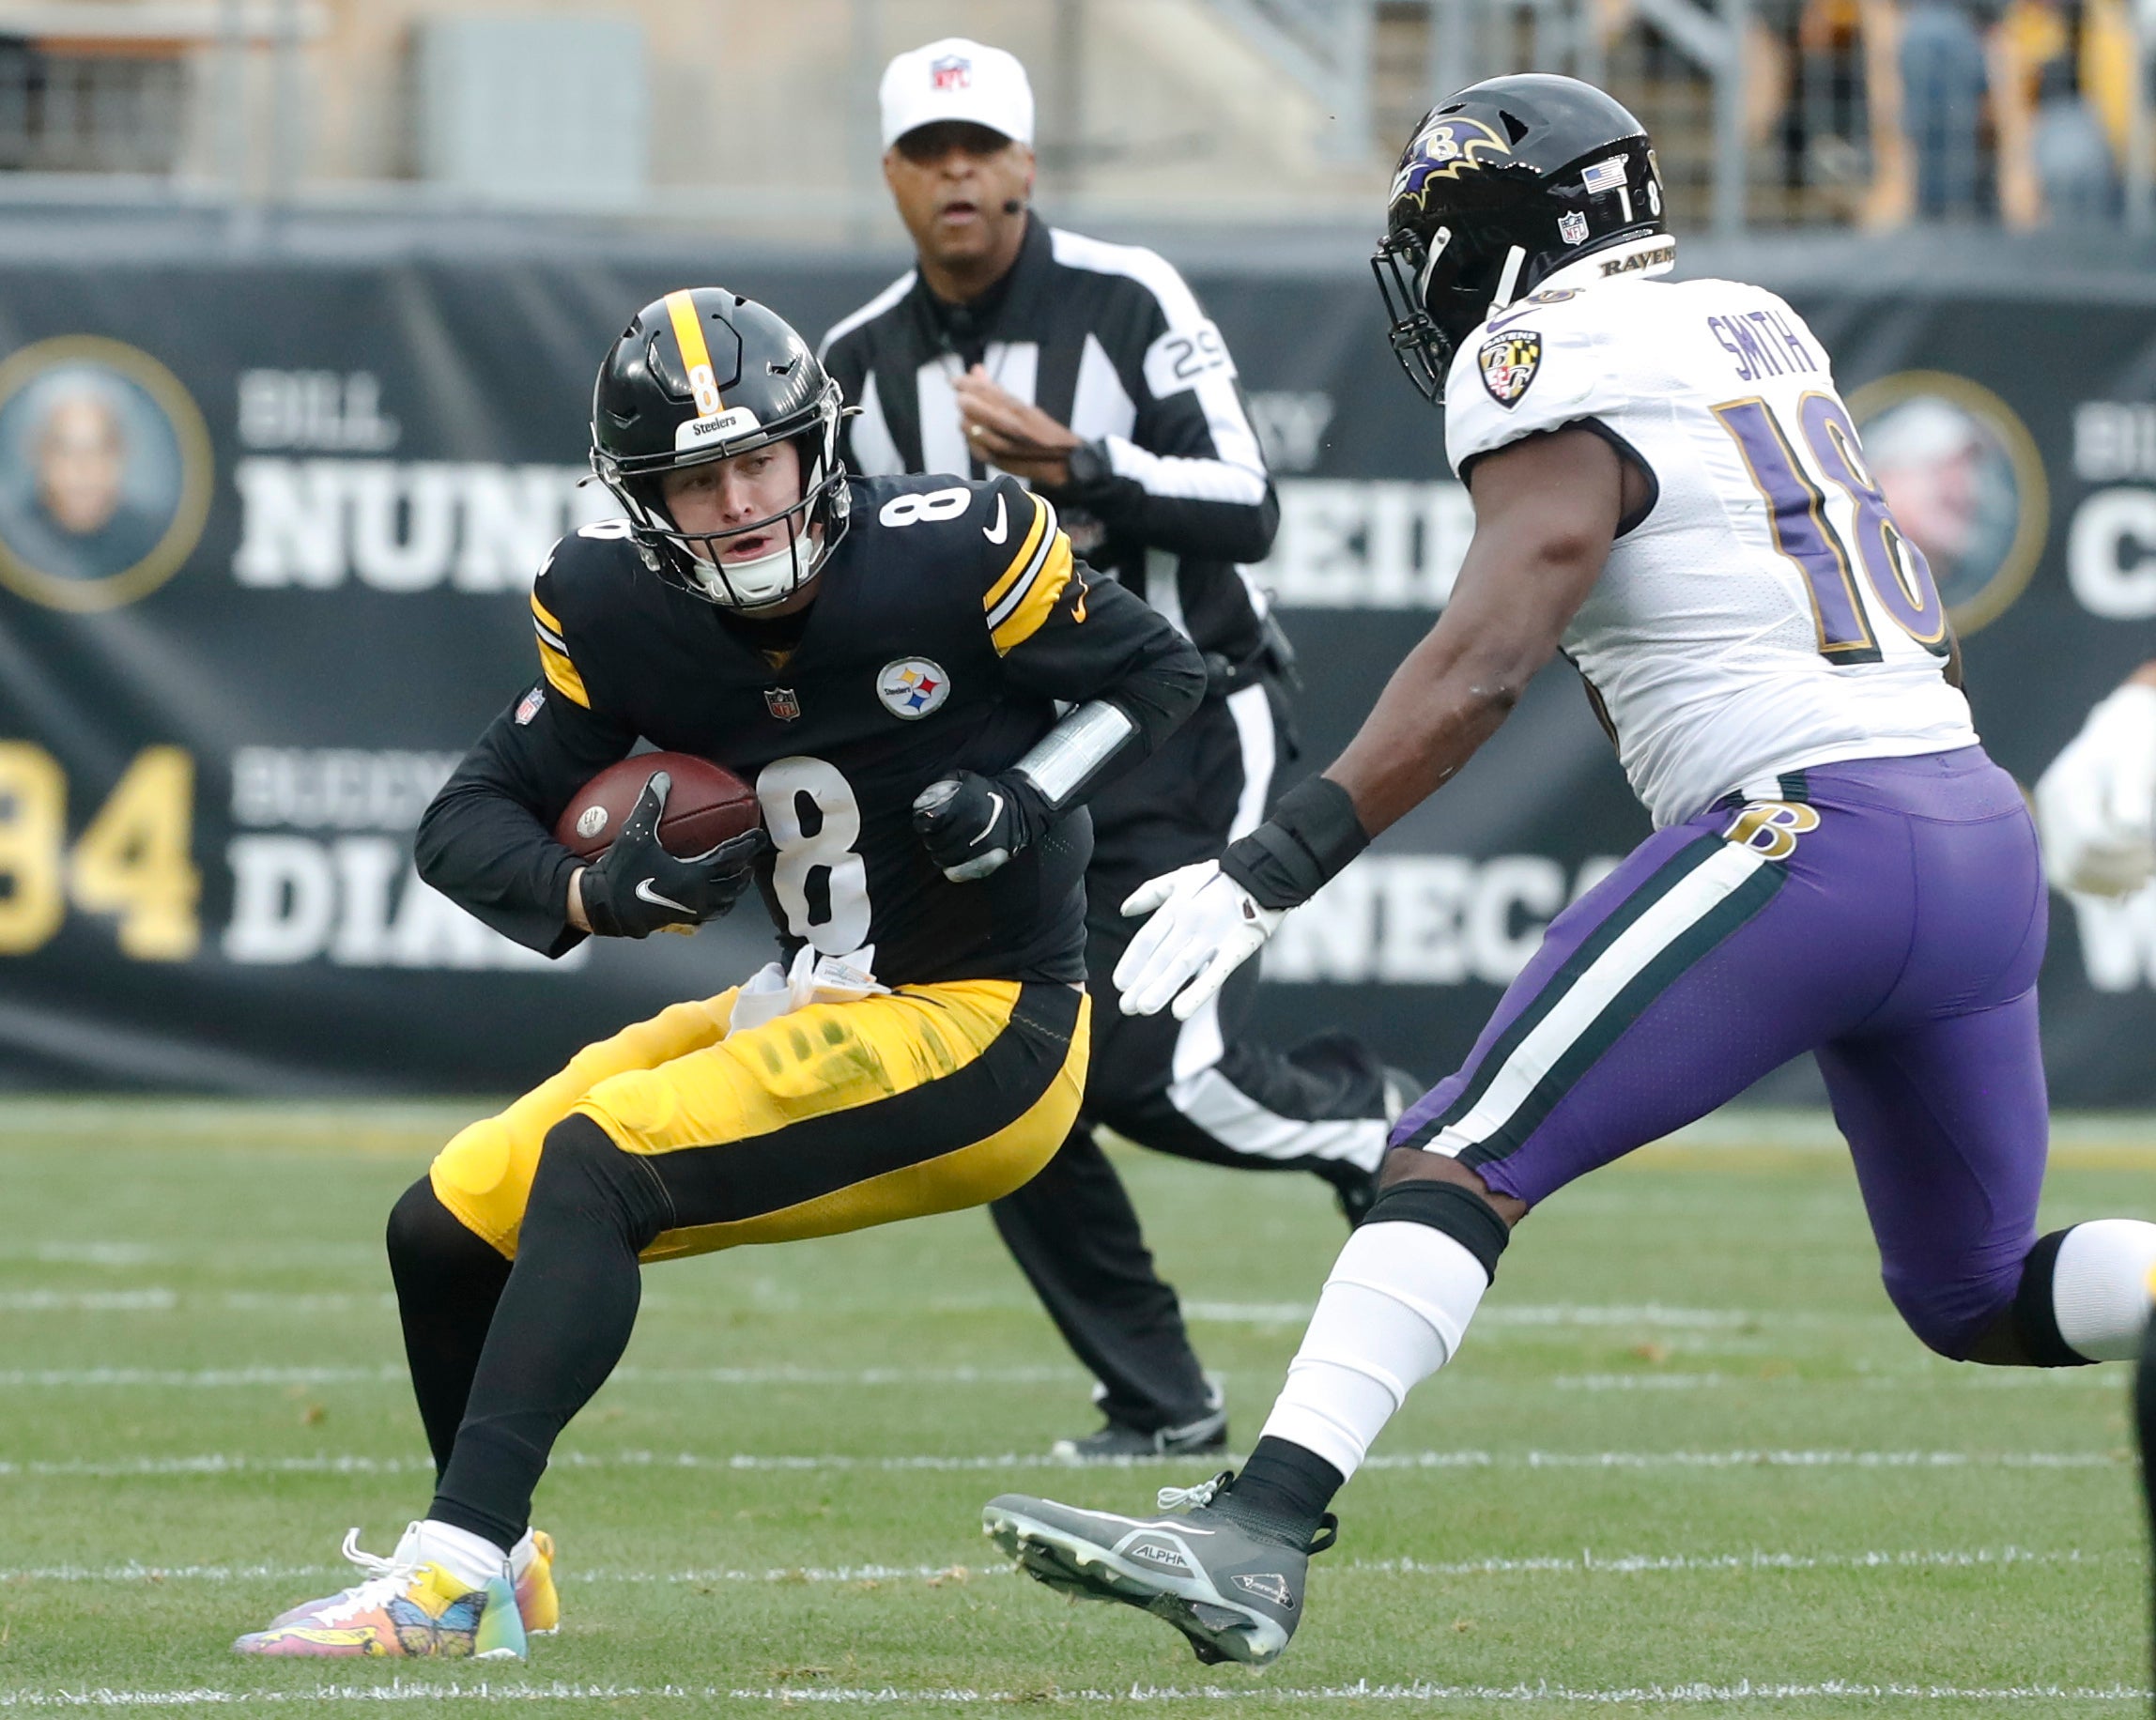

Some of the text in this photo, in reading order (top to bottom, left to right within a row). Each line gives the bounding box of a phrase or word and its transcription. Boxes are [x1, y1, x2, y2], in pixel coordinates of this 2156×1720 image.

[1564, 225, 1585, 240] NFL
[1707, 310, 1819, 381] SMITH
[688, 363, 720, 415] 8
[692, 416, 737, 436] Steelers
[880, 487, 971, 529] 8
[1708, 390, 1950, 667] 18
[756, 756, 871, 956] 8
[1135, 1545, 1188, 1567] ALPHA
